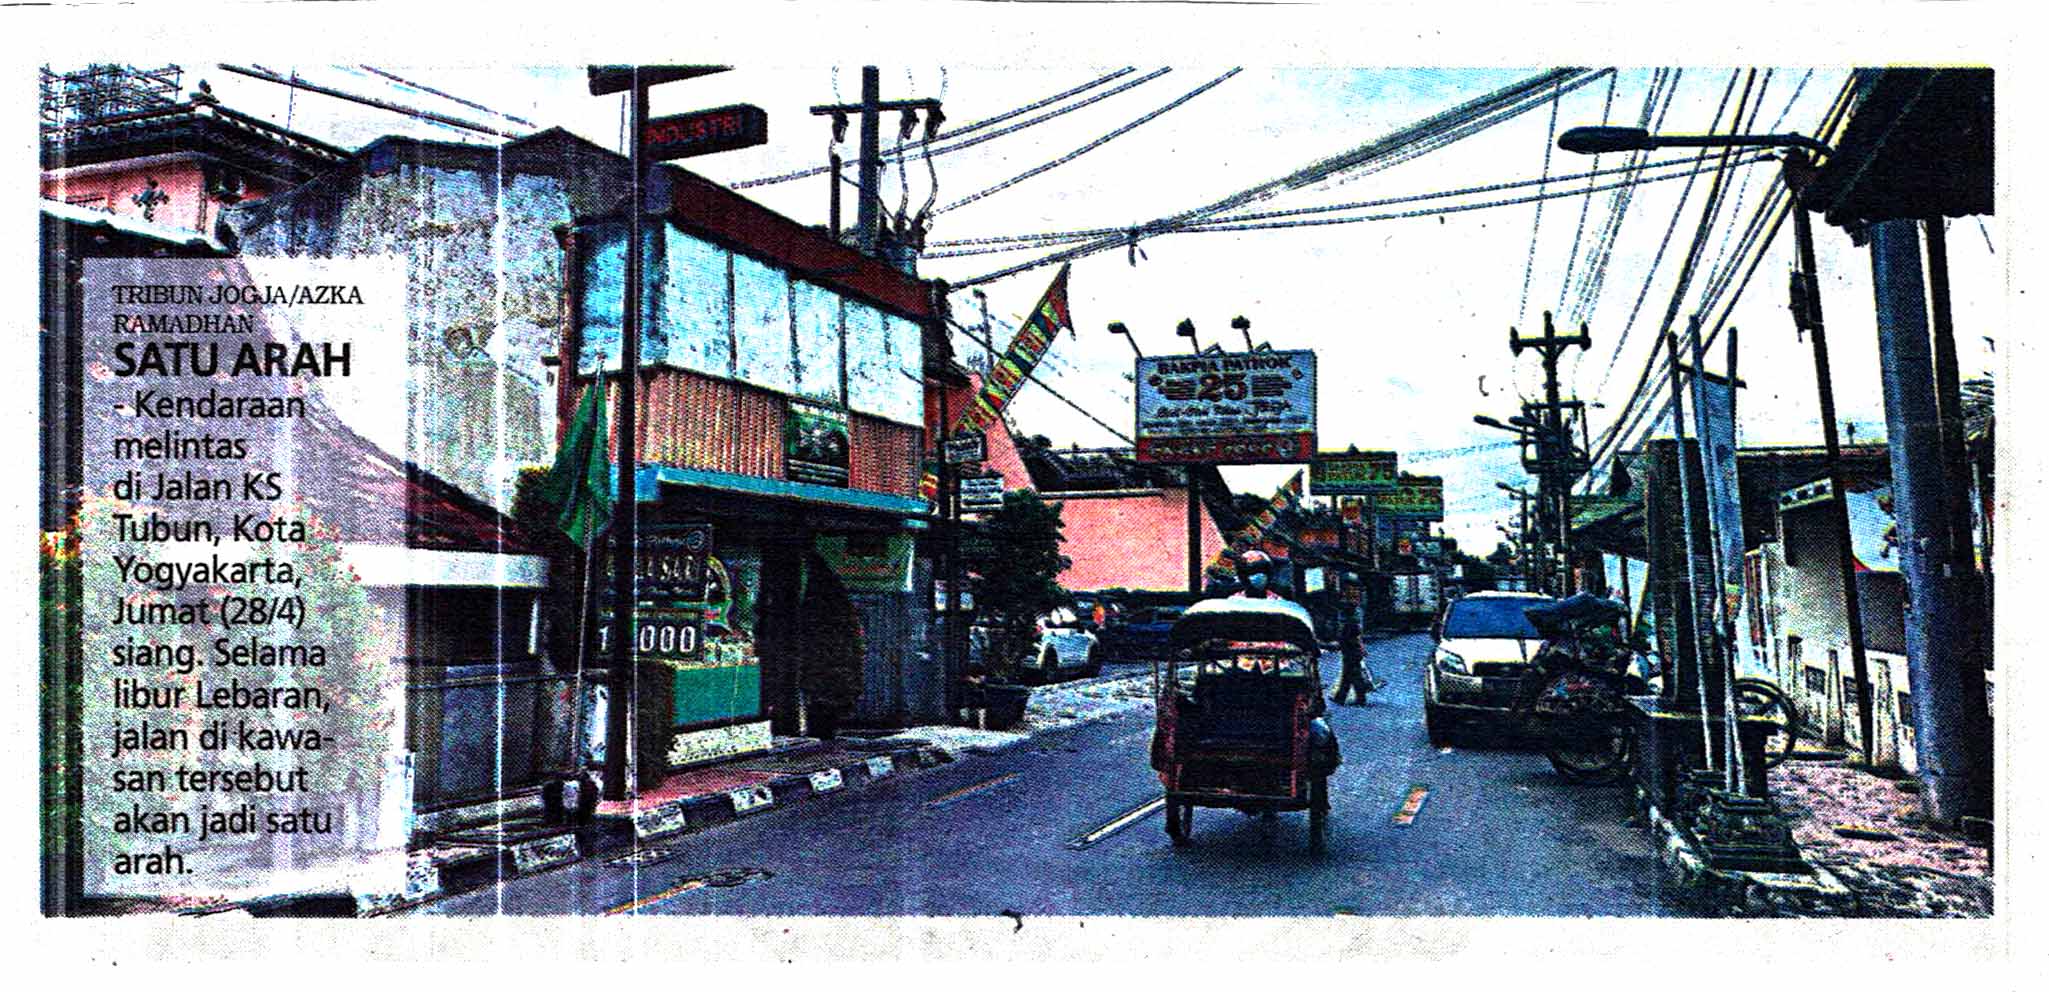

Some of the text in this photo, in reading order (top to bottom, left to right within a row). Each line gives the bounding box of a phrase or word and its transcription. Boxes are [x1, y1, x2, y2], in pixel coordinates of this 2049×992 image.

[1157, 359, 1219, 375] BAKPIA
[1197, 373, 1249, 401] 25
[599, 624, 696, 653] 1000
